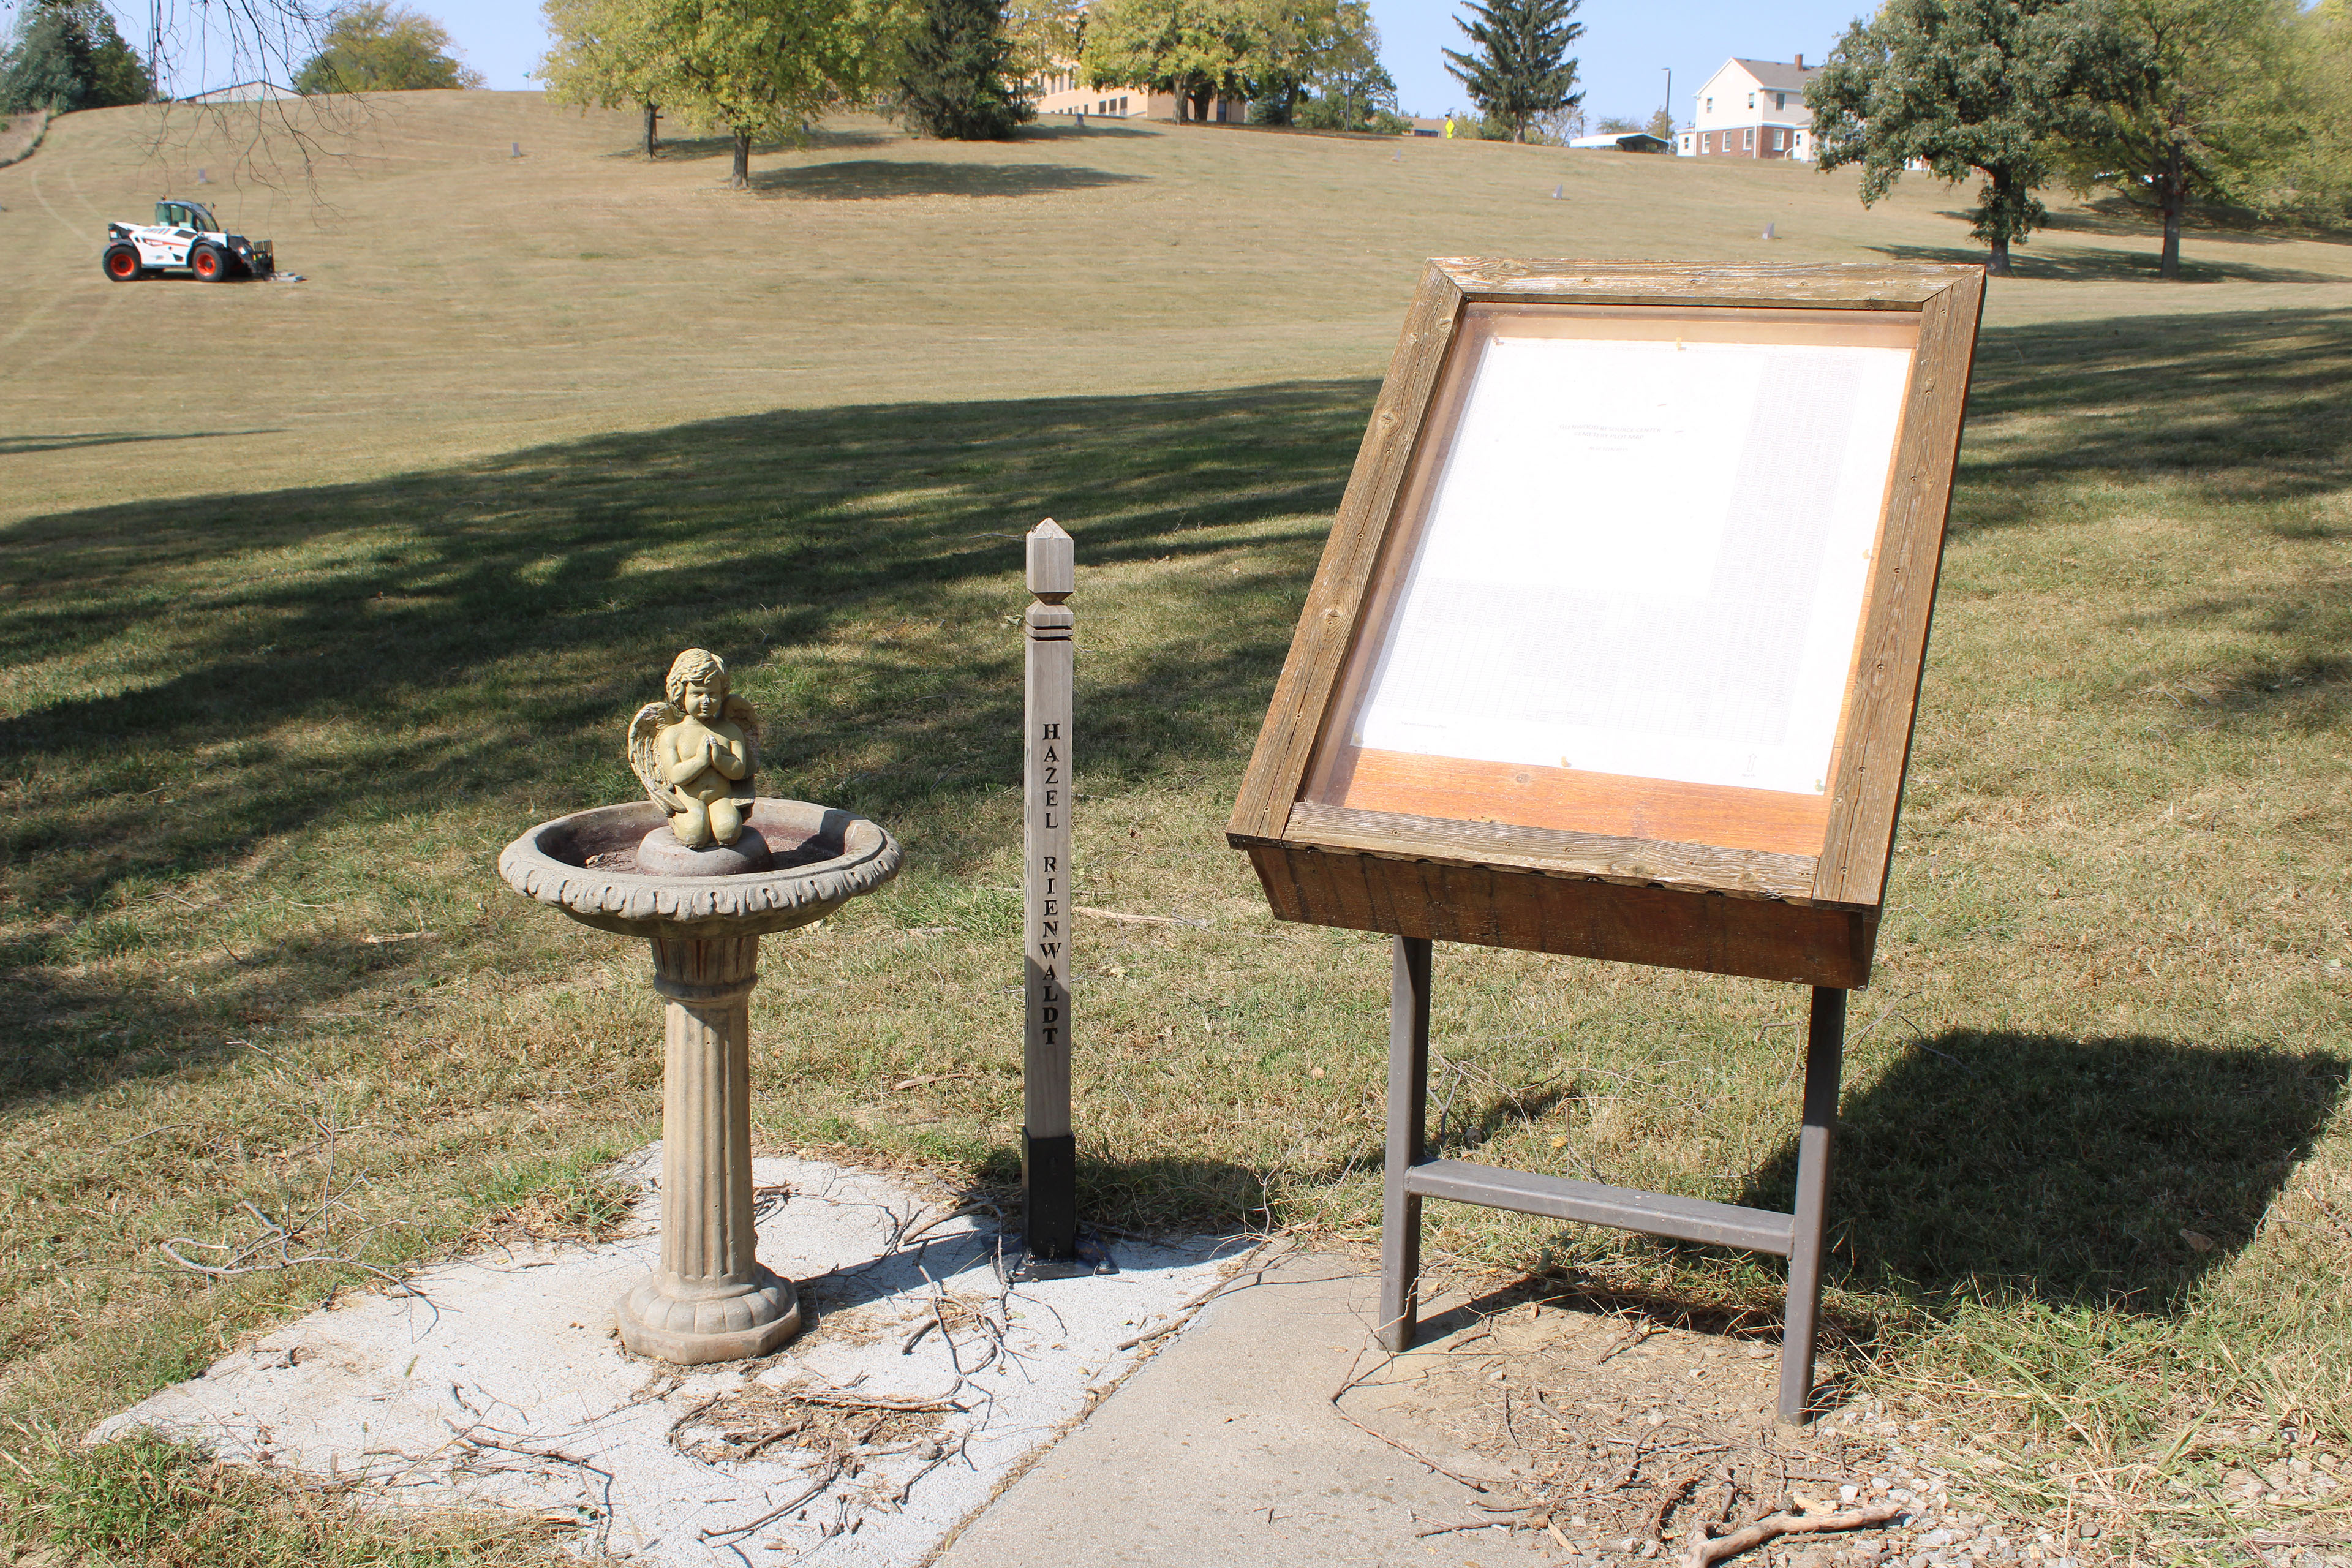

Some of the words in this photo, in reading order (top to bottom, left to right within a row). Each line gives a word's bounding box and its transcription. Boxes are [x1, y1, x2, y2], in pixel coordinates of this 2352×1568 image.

[1025, 720, 1030, 769] IN
[1042, 723, 1060, 829] HAZEL
[1039, 856, 1061, 1045] RIENWALDT
[1025, 992, 1030, 1036] OF
